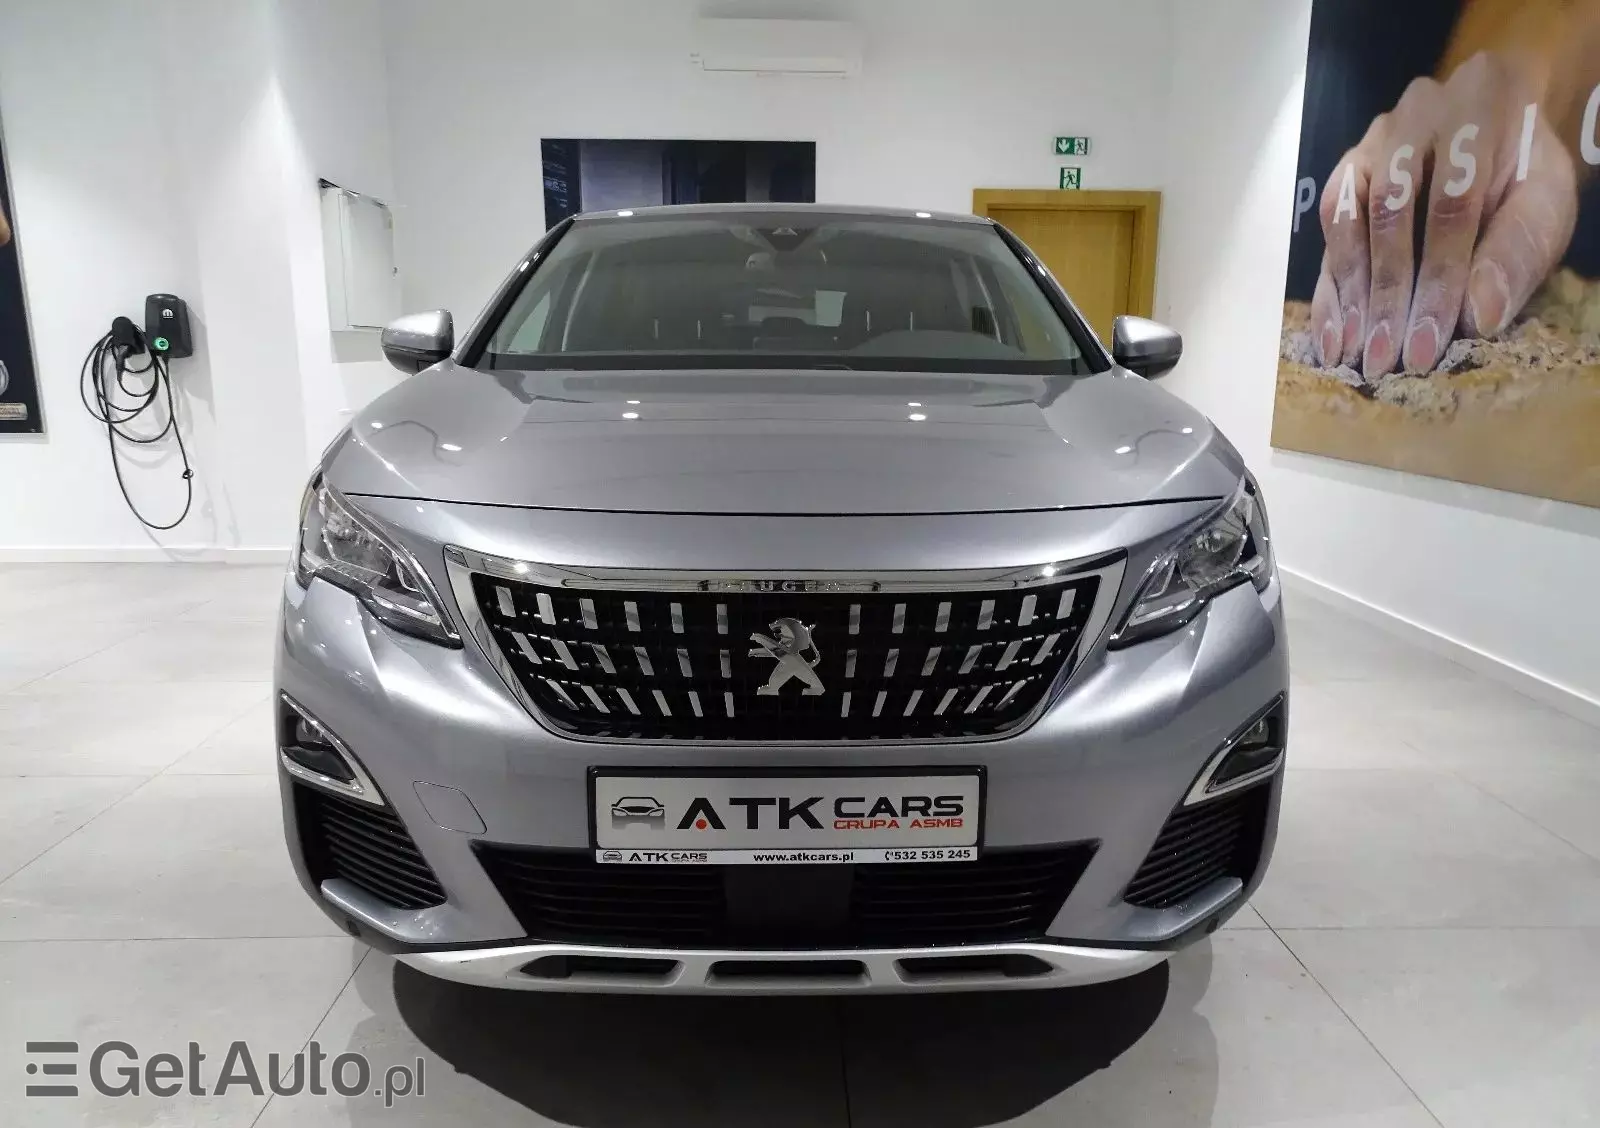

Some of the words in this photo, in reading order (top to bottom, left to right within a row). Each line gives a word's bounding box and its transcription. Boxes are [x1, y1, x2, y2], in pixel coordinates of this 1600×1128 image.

[676, 797, 825, 829] ATK
[834, 795, 964, 818] CARS
[833, 819, 900, 829] GRUPA
[910, 818, 963, 828] ASMB
[629, 852, 669, 862] ATK
[753, 852, 854, 862] www.atkcars.pl
[894, 851, 917, 860] 532
[921, 850, 944, 859] 535
[947, 849, 971, 858] 245
